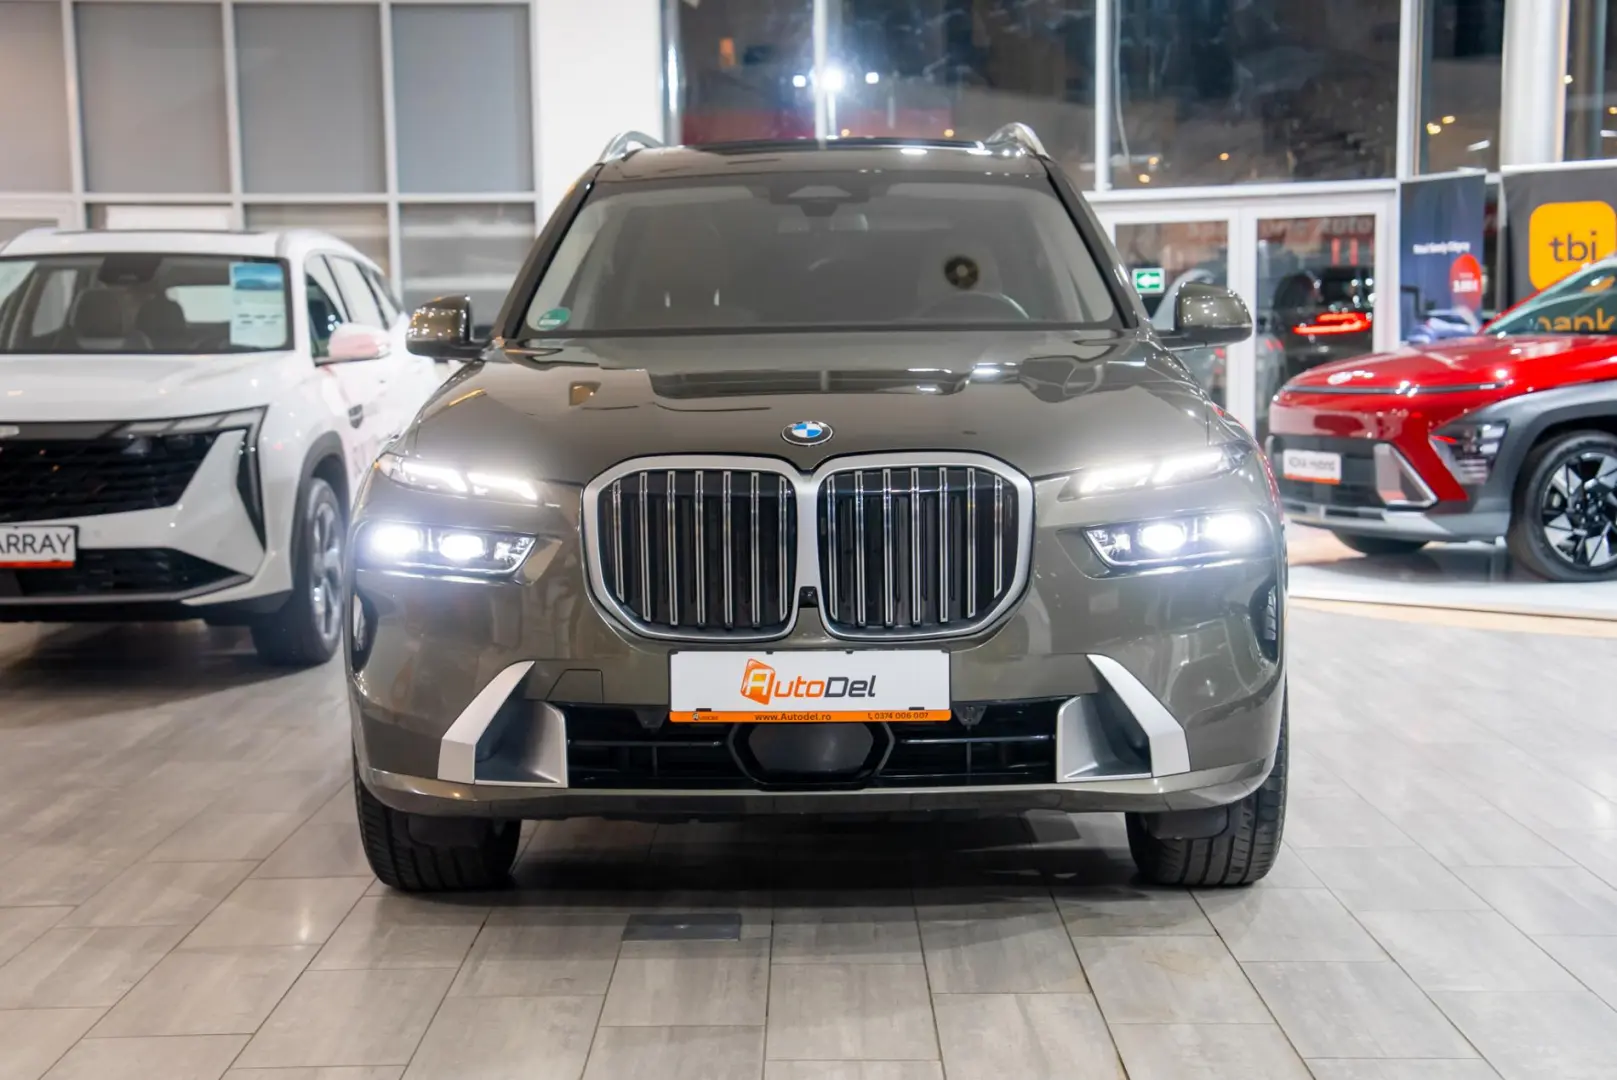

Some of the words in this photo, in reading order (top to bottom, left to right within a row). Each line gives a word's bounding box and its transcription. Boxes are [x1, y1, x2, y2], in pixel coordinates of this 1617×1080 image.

[1548, 231, 1598, 264] tbi
[743, 662, 876, 702] AutoDel
[755, 712, 831, 721] www.Autodel.ro
[874, 712, 893, 720] 0374
[895, 711, 912, 719] 006
[913, 711, 929, 719] 007
